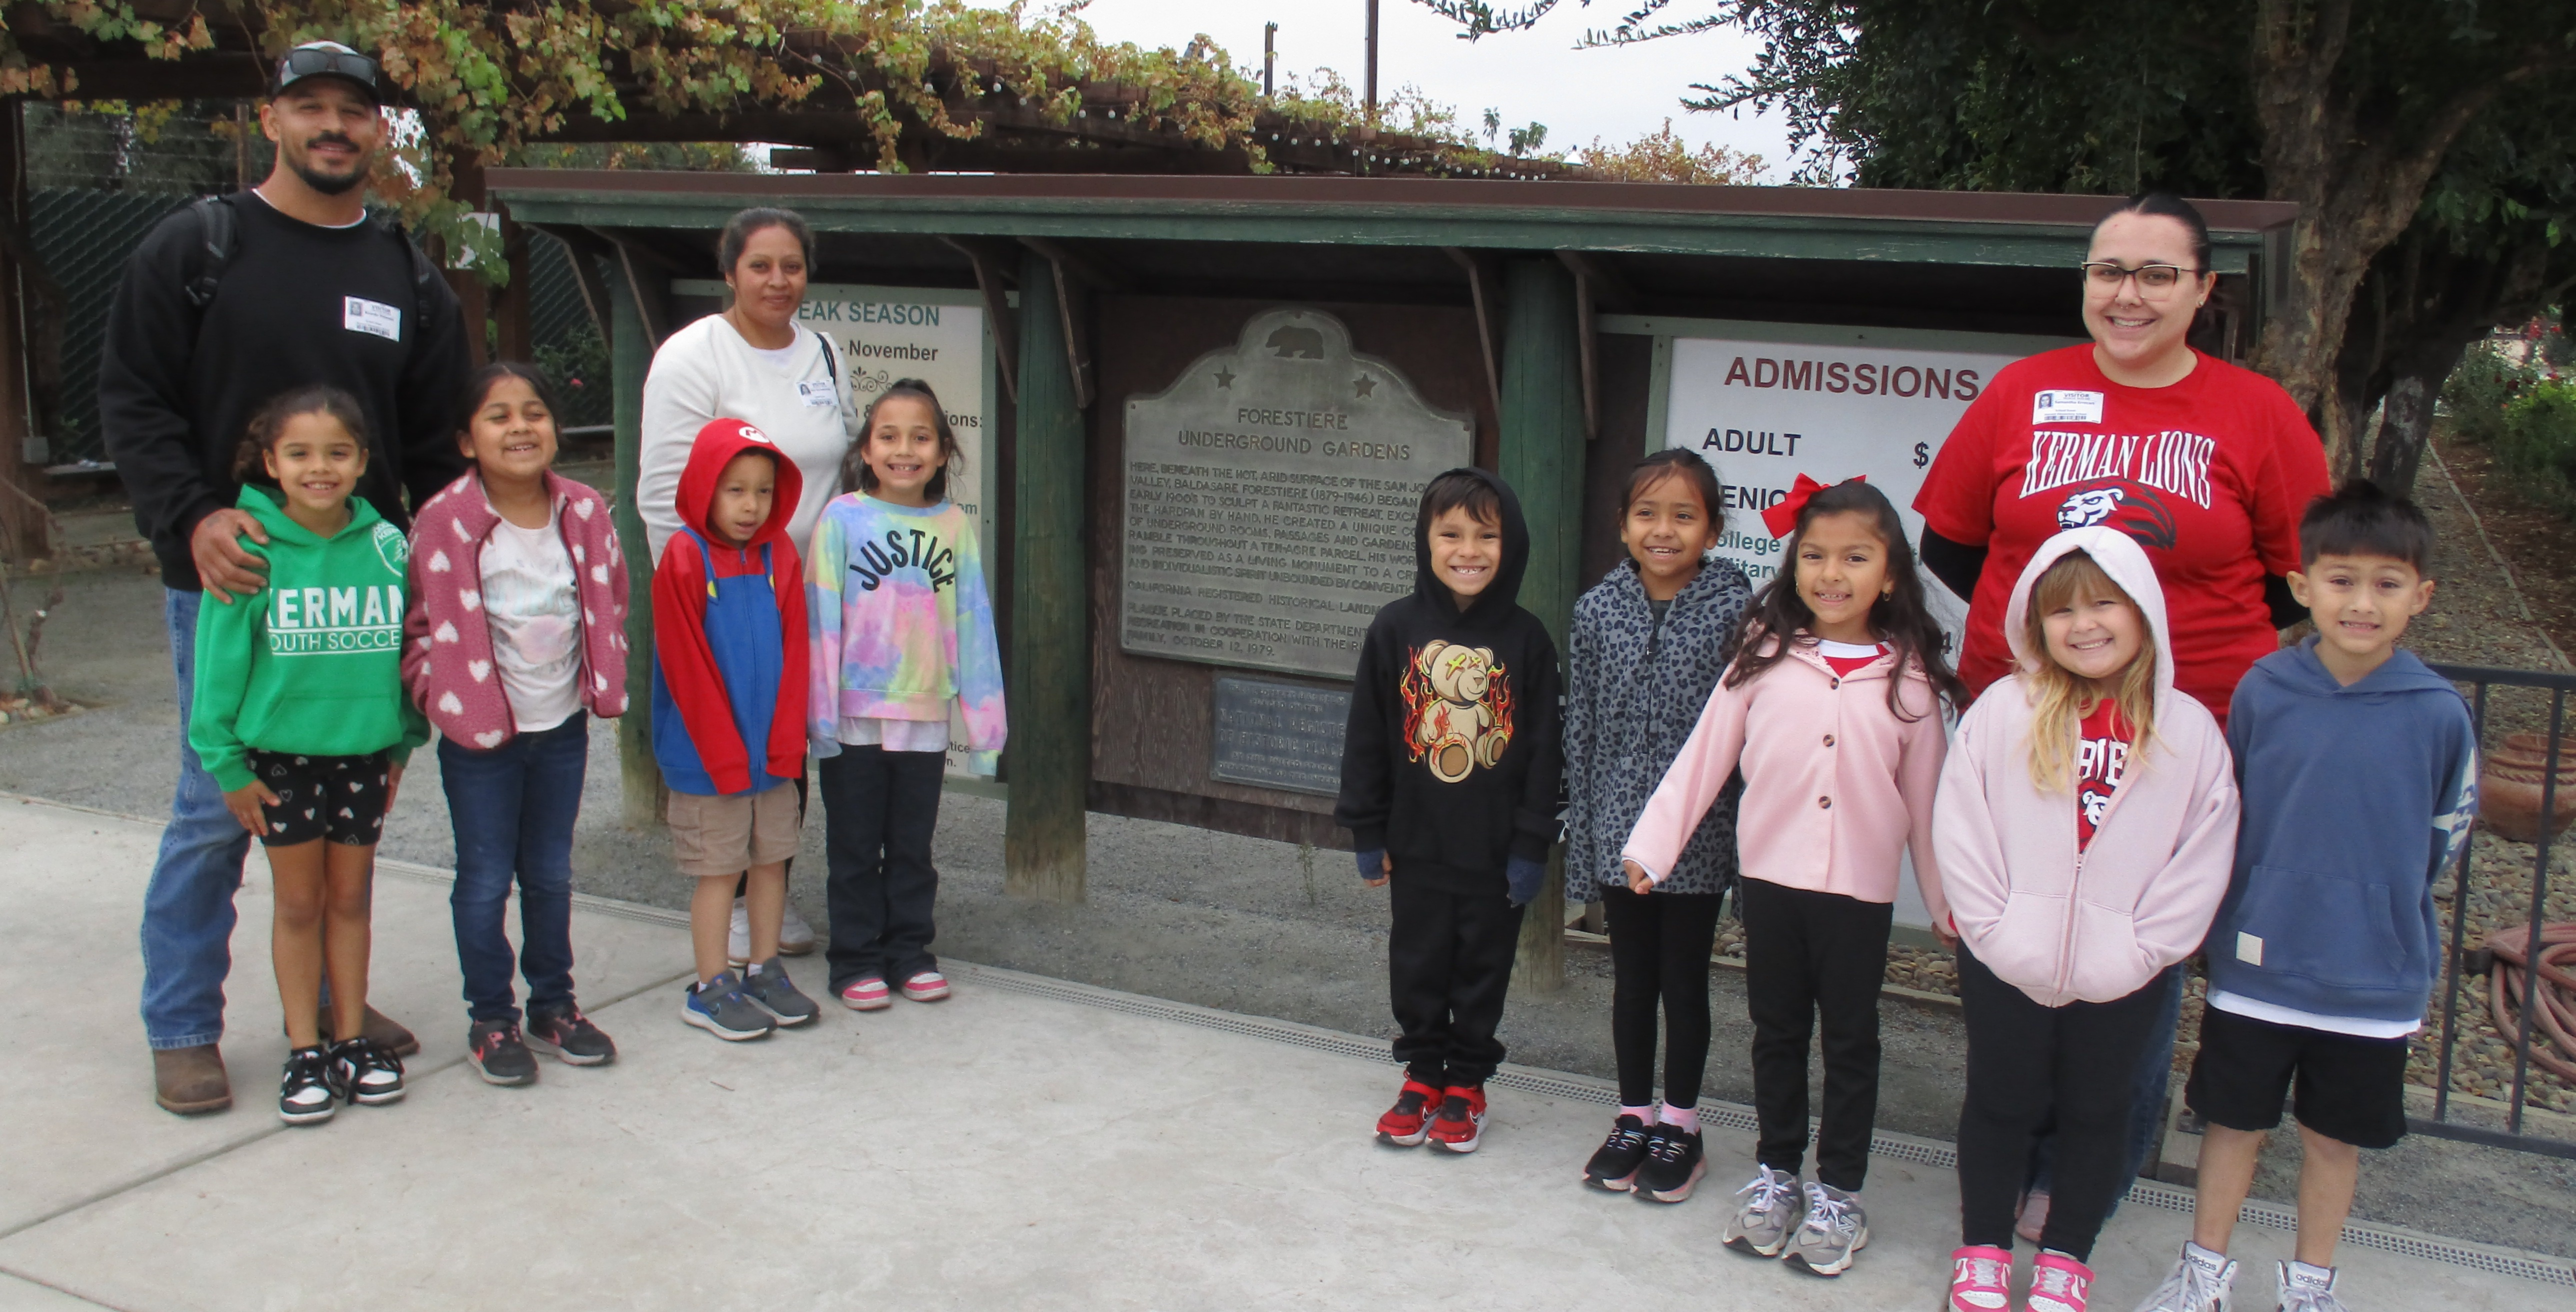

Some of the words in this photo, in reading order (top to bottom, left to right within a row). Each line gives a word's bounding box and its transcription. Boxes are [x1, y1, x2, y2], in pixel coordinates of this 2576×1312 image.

[799, 300, 842, 321] EAK
[848, 302, 939, 326] SEASON
[850, 340, 938, 361] November
[1724, 356, 1978, 401] ADMISSIONS
[1238, 408, 1348, 430] FORESTIERE
[1178, 430, 1312, 454] UNDERGROUND
[1322, 440, 1410, 460] GARDENS
[1702, 428, 1801, 456] ADULT
[1914, 441, 1929, 469] $
[1161, 462, 1208, 476] BENEATH
[1212, 467, 1232, 478] THE
[1236, 469, 1258, 481] HOT,
[1260, 471, 1287, 483] ARID
[1290, 474, 1338, 486] SURFACE
[1340, 477, 1356, 488] OF
[1358, 478, 1382, 490] THE
[1384, 480, 1406, 492] SAN
[2018, 431, 2140, 499] KERMAN
[2138, 430, 2216, 510] LIONS
[1130, 476, 1172, 488] VALLEY,
[1174, 478, 1238, 493] BALDASARE
[1242, 484, 1308, 499] FORESTIERE
[1311, 487, 1374, 504] (1879-1946)
[1378, 494, 1417, 508] BEGAN
[1130, 489, 1162, 501] EARLY
[1202, 494, 1216, 506] TO
[1218, 496, 1258, 508] SCULPT
[1261, 500, 1270, 510] A
[1272, 500, 1330, 516] FANTASTIC
[1388, 510, 1418, 522] EXCA
[1721, 485, 1786, 510] ENIO
[1130, 503, 1150, 513] THE
[1154, 505, 1204, 518] HARDPAN
[1210, 509, 1224, 520] BY
[1228, 511, 1261, 524] HAND,
[1264, 514, 1279, 525] HE
[1283, 516, 1336, 530] CREATED
[1339, 520, 1348, 531] A
[1352, 521, 1396, 534] UNIQUE
[1130, 516, 1144, 526] OF
[1147, 518, 1226, 534] UNDERGROUND
[1230, 526, 1271, 539] ROOMS,
[1274, 529, 1330, 544] PASSAGES
[1334, 534, 1358, 546] AND
[1362, 537, 1416, 550] GARDENS
[1128, 530, 1172, 543] RAMBLE
[1176, 534, 1248, 550] THROUGHOUT
[1250, 540, 1258, 552] A
[1261, 542, 1316, 557] TEN-ACRE
[1368, 552, 1386, 563] HIS
[1389, 554, 1416, 566] WOR
[1717, 530, 1780, 556] ollege
[850, 528, 955, 593] JUSTICE
[1152, 546, 1214, 560] PRESERVED
[1218, 552, 1232, 562] AS
[1235, 554, 1244, 564] A
[1248, 554, 1286, 567] LIVING
[1292, 559, 1358, 575] MONUMENT
[1363, 566, 1378, 576] TO
[1382, 568, 1392, 578] A
[1128, 558, 1150, 569] AND
[1152, 560, 1234, 577] INDIVIDUALISTIC
[1234, 568, 1266, 580] SPIRIT
[1268, 570, 1334, 588] UNBOUNDED
[1336, 578, 1350, 588] BY
[1352, 580, 1415, 594] CONVENTIO
[267, 584, 404, 628] ERMAN
[1128, 580, 1192, 596] CALIFORNIA
[1198, 587, 1262, 604] REGISTERED
[1268, 594, 1335, 611] HISTORICAL
[1340, 602, 1380, 616] LANDM
[1172, 606, 1212, 621] PLACED
[1216, 612, 1230, 623] BY
[1234, 614, 1254, 626] THE
[1258, 616, 1290, 630] STATE
[1295, 620, 1368, 638] DEPARTMENT
[1194, 624, 1206, 634] IN
[1210, 626, 1286, 644] COOPERATION
[1292, 634, 1320, 646] WITH
[1324, 638, 1346, 650] THE
[270, 633, 322, 651] OUTH
[327, 630, 400, 650] SOCCE
[1174, 636, 1224, 649] OCTOBER
[1248, 643, 1276, 656] 1979.
[1290, 718, 1346, 738] REGISTE
[946, 758, 956, 767] n.
[950, 741, 970, 754] tice
[1304, 740, 1345, 757] PLACE
[2186, 1253, 2217, 1271] adidas
